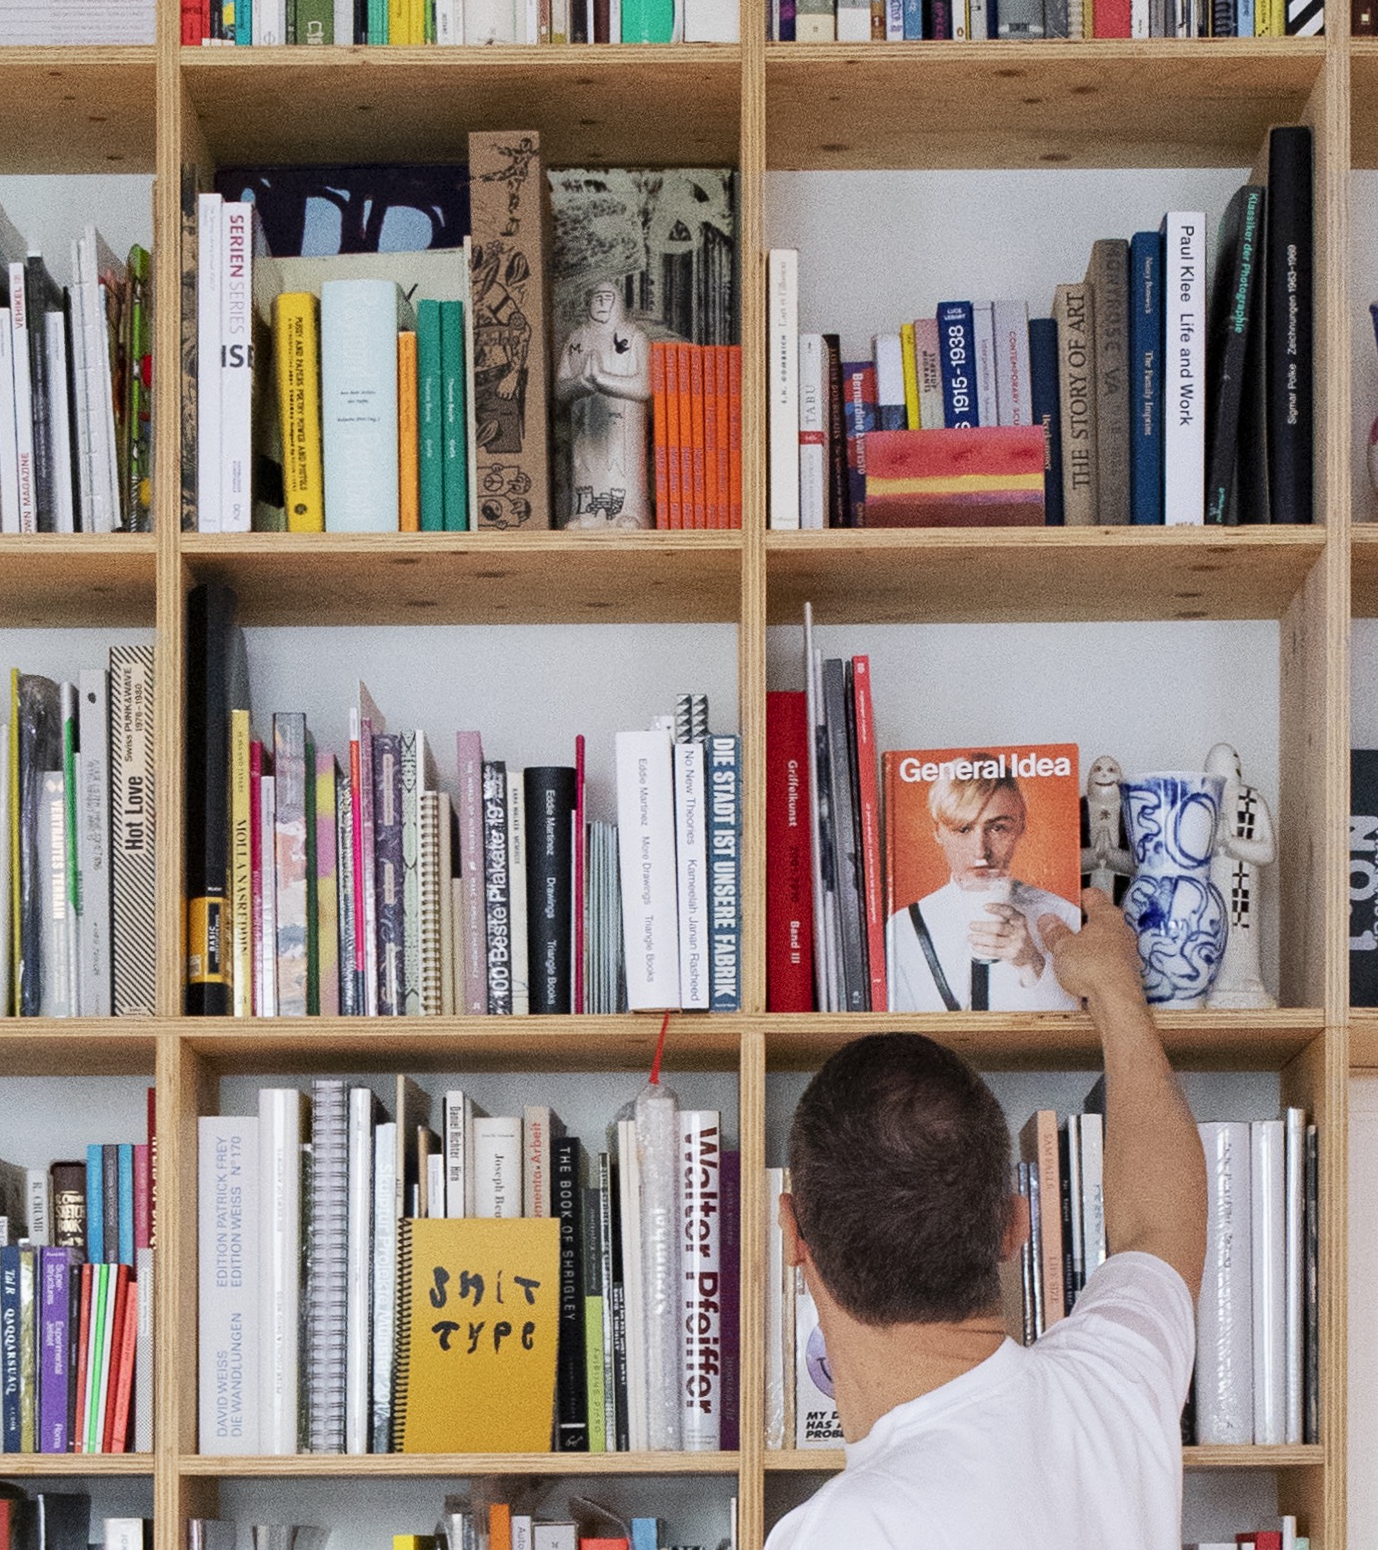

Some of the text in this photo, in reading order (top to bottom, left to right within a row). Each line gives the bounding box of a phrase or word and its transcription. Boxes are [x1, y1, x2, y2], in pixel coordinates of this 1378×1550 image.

[229, 215, 245, 334] SERIEN SERIES
[948, 325, 969, 415] 1915-1938
[1180, 225, 1195, 426] Paul Klee Life and Work
[804, 384, 815, 425] TABU
[1066, 292, 1090, 490] THE STORY OF ART
[638, 758, 648, 784] Eddie
[685, 751, 696, 767] No
[686, 770, 696, 794] New
[898, 752, 1071, 783] General Idea
[124, 776, 144, 850] Hot Love
[686, 797, 697, 845] Theories
[544, 789, 557, 1005] Eddie Martinez Drawings Triangle Books
[713, 737, 735, 997] DIE STADT IST UNSERE FABRIK
[487, 830, 508, 998] 100 Beste Plakate
[492, 1153, 505, 1192] Joseph
[559, 1147, 575, 1321] THE BOOK OF SHRIGLEY
[685, 1126, 719, 1414] Walter Pfeiffer
